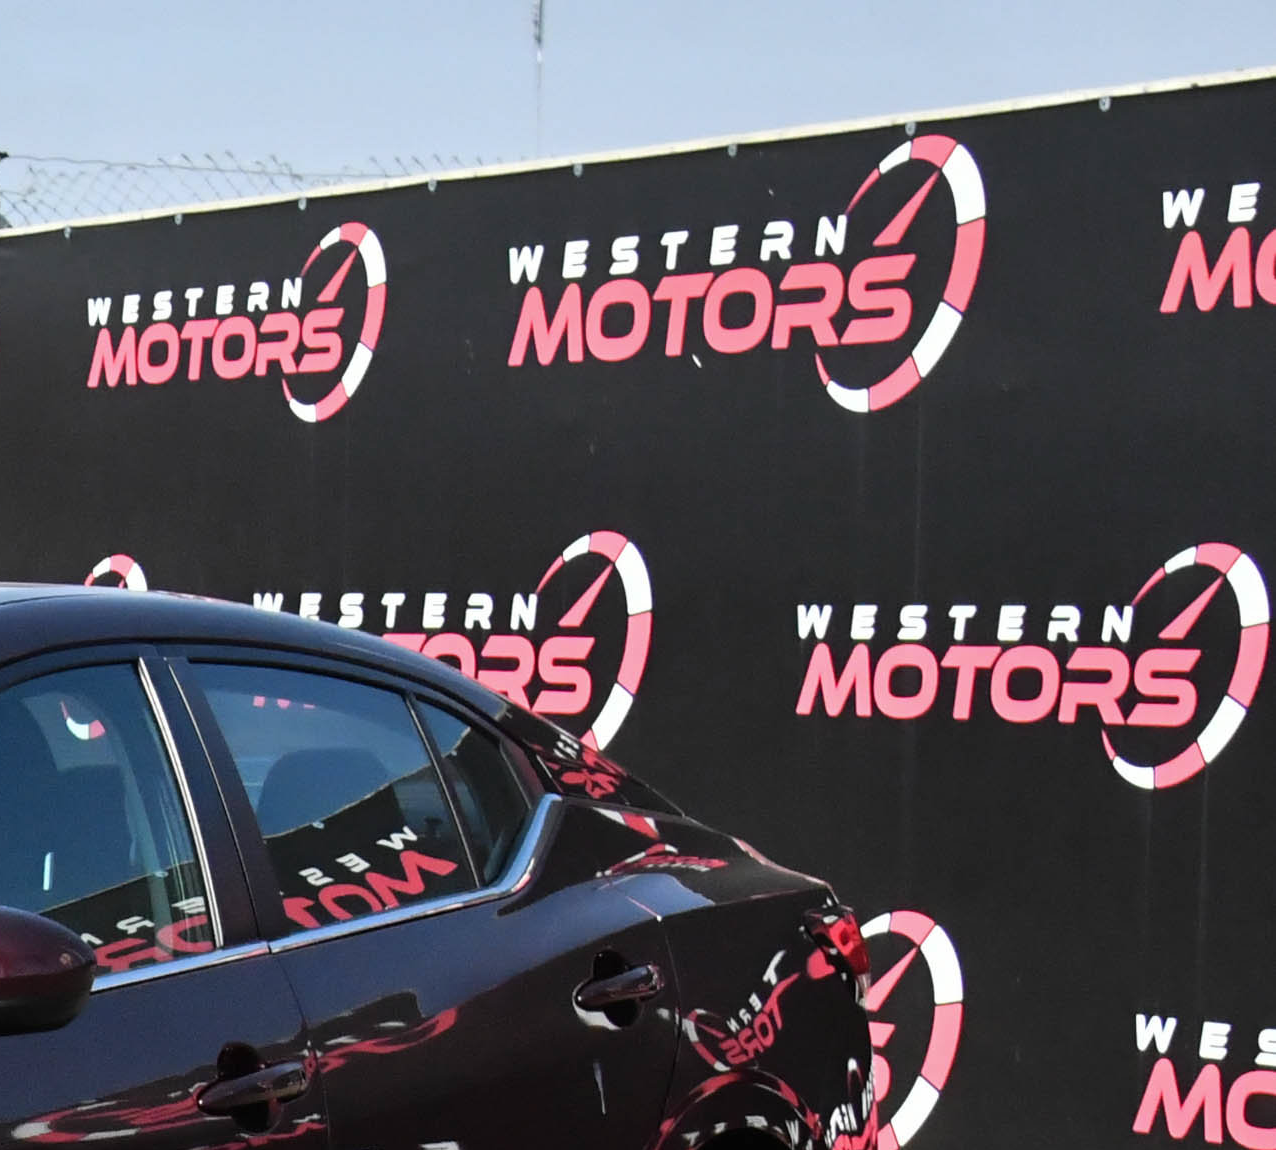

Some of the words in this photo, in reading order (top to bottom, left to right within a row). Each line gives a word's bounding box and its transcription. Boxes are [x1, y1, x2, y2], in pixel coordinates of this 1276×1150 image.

[1162, 181, 1261, 229] WE
[509, 215, 847, 284] WESTERN
[1159, 226, 1276, 313] M
[88, 277, 302, 326] WESTERN
[508, 253, 916, 366] MOTORS
[87, 308, 345, 388] MOTORS
[797, 605, 1133, 642] WESTERN
[796, 643, 1201, 727] MOTORS
